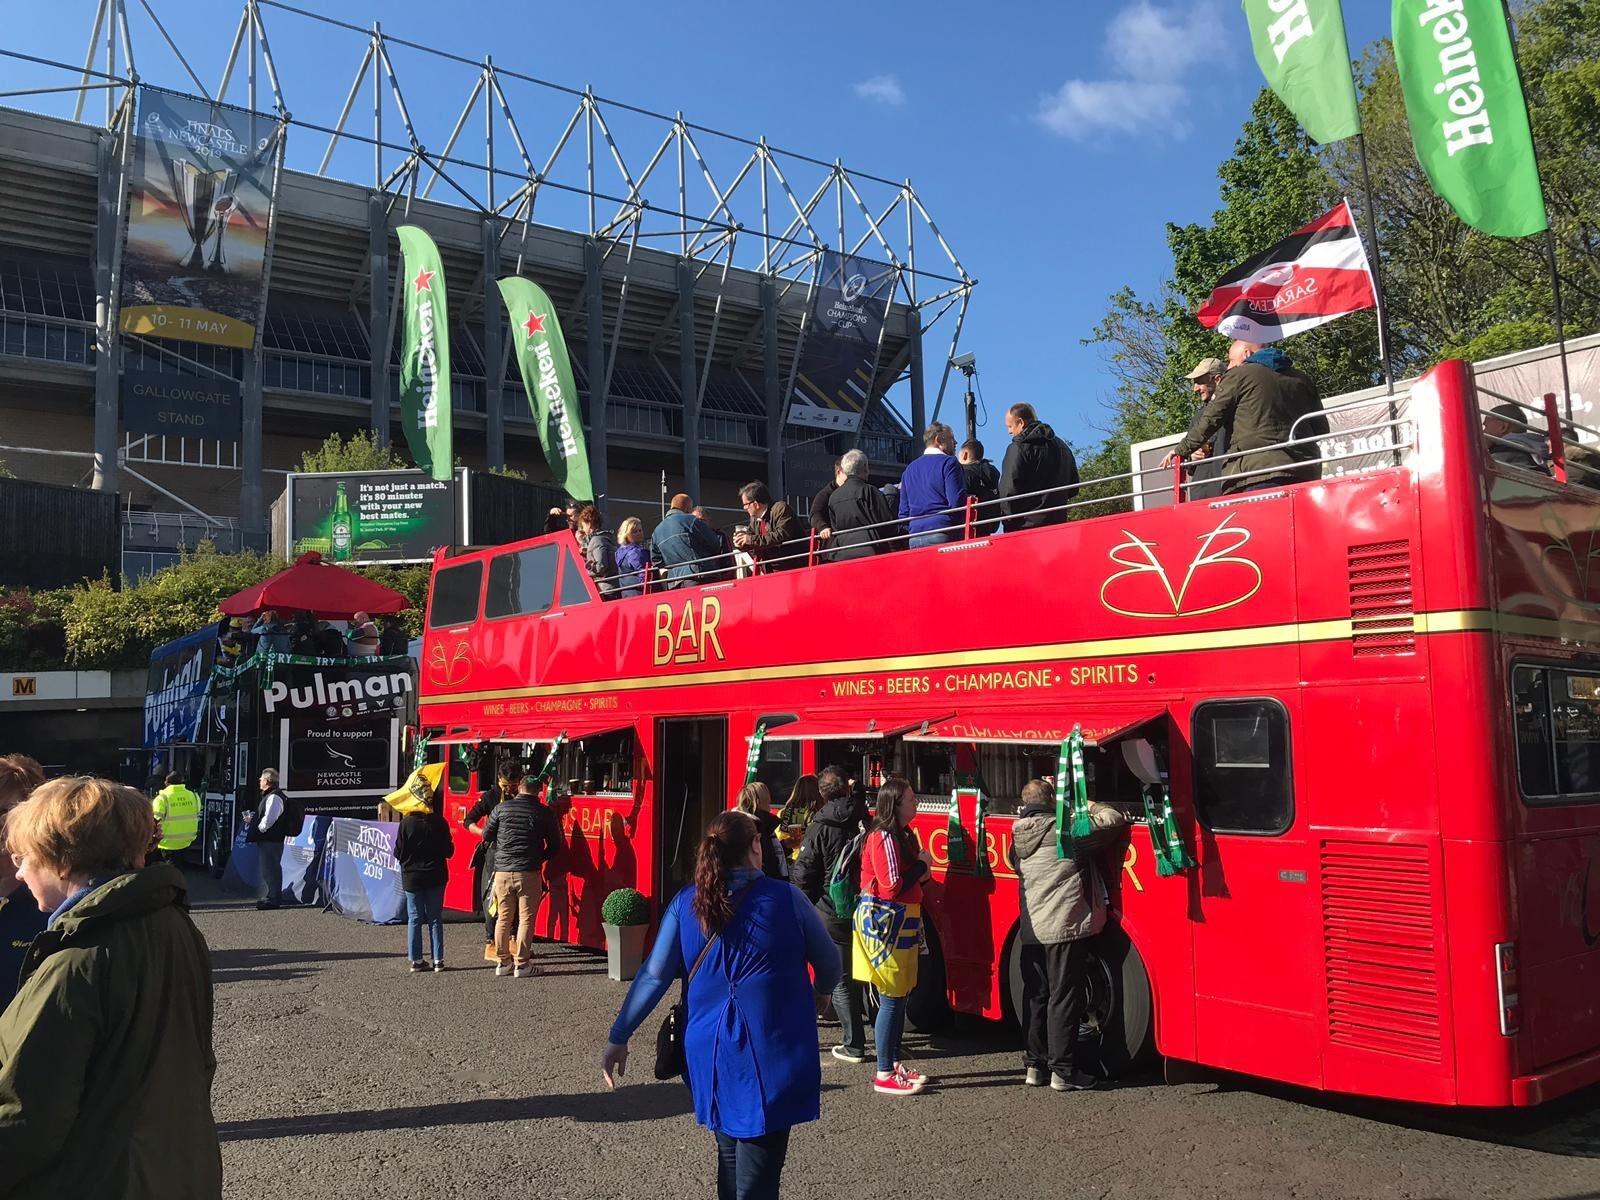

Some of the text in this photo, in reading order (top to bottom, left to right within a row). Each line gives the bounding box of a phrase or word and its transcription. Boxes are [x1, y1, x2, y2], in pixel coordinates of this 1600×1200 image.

[186, 120, 234, 142] FINALS
[169, 129, 248, 155] NEWCASTLE
[195, 145, 222, 159] 2019
[179, 318, 191, 329] 11
[196, 320, 228, 334] MAY
[416, 300, 438, 430] Heineken
[133, 384, 231, 405] GALLOWGATE
[534, 340, 579, 459] Heineken
[158, 411, 205, 426] STAND
[1317, 438, 1347, 459] t's
[360, 484, 373, 492] It's
[374, 483, 389, 492] not
[390, 483, 408, 492] just
[417, 482, 447, 490] match,
[387, 492, 423, 500] minutes
[382, 503, 403, 511] your
[360, 512, 379, 520] best
[653, 595, 725, 666] BAR
[276, 653, 293, 665] RY
[315, 656, 337, 666] TRY
[364, 655, 385, 664] TRY
[14, 678, 35, 694] M
[833, 664, 1138, 697] WINES BEERS CHAMPAGNE SPIRITS
[263, 672, 413, 713] Pulman
[483, 697, 618, 716] WINES BEERS CHAMPAGNE SPIRITS
[307, 729, 331, 738] Proud
[342, 730, 373, 739] support
[317, 778, 362, 786] FALCONS
[582, 807, 614, 842] BAR
[357, 825, 391, 852] FINALS
[347, 840, 401, 872] NEWCASTLE
[363, 863, 383, 880] 2019
